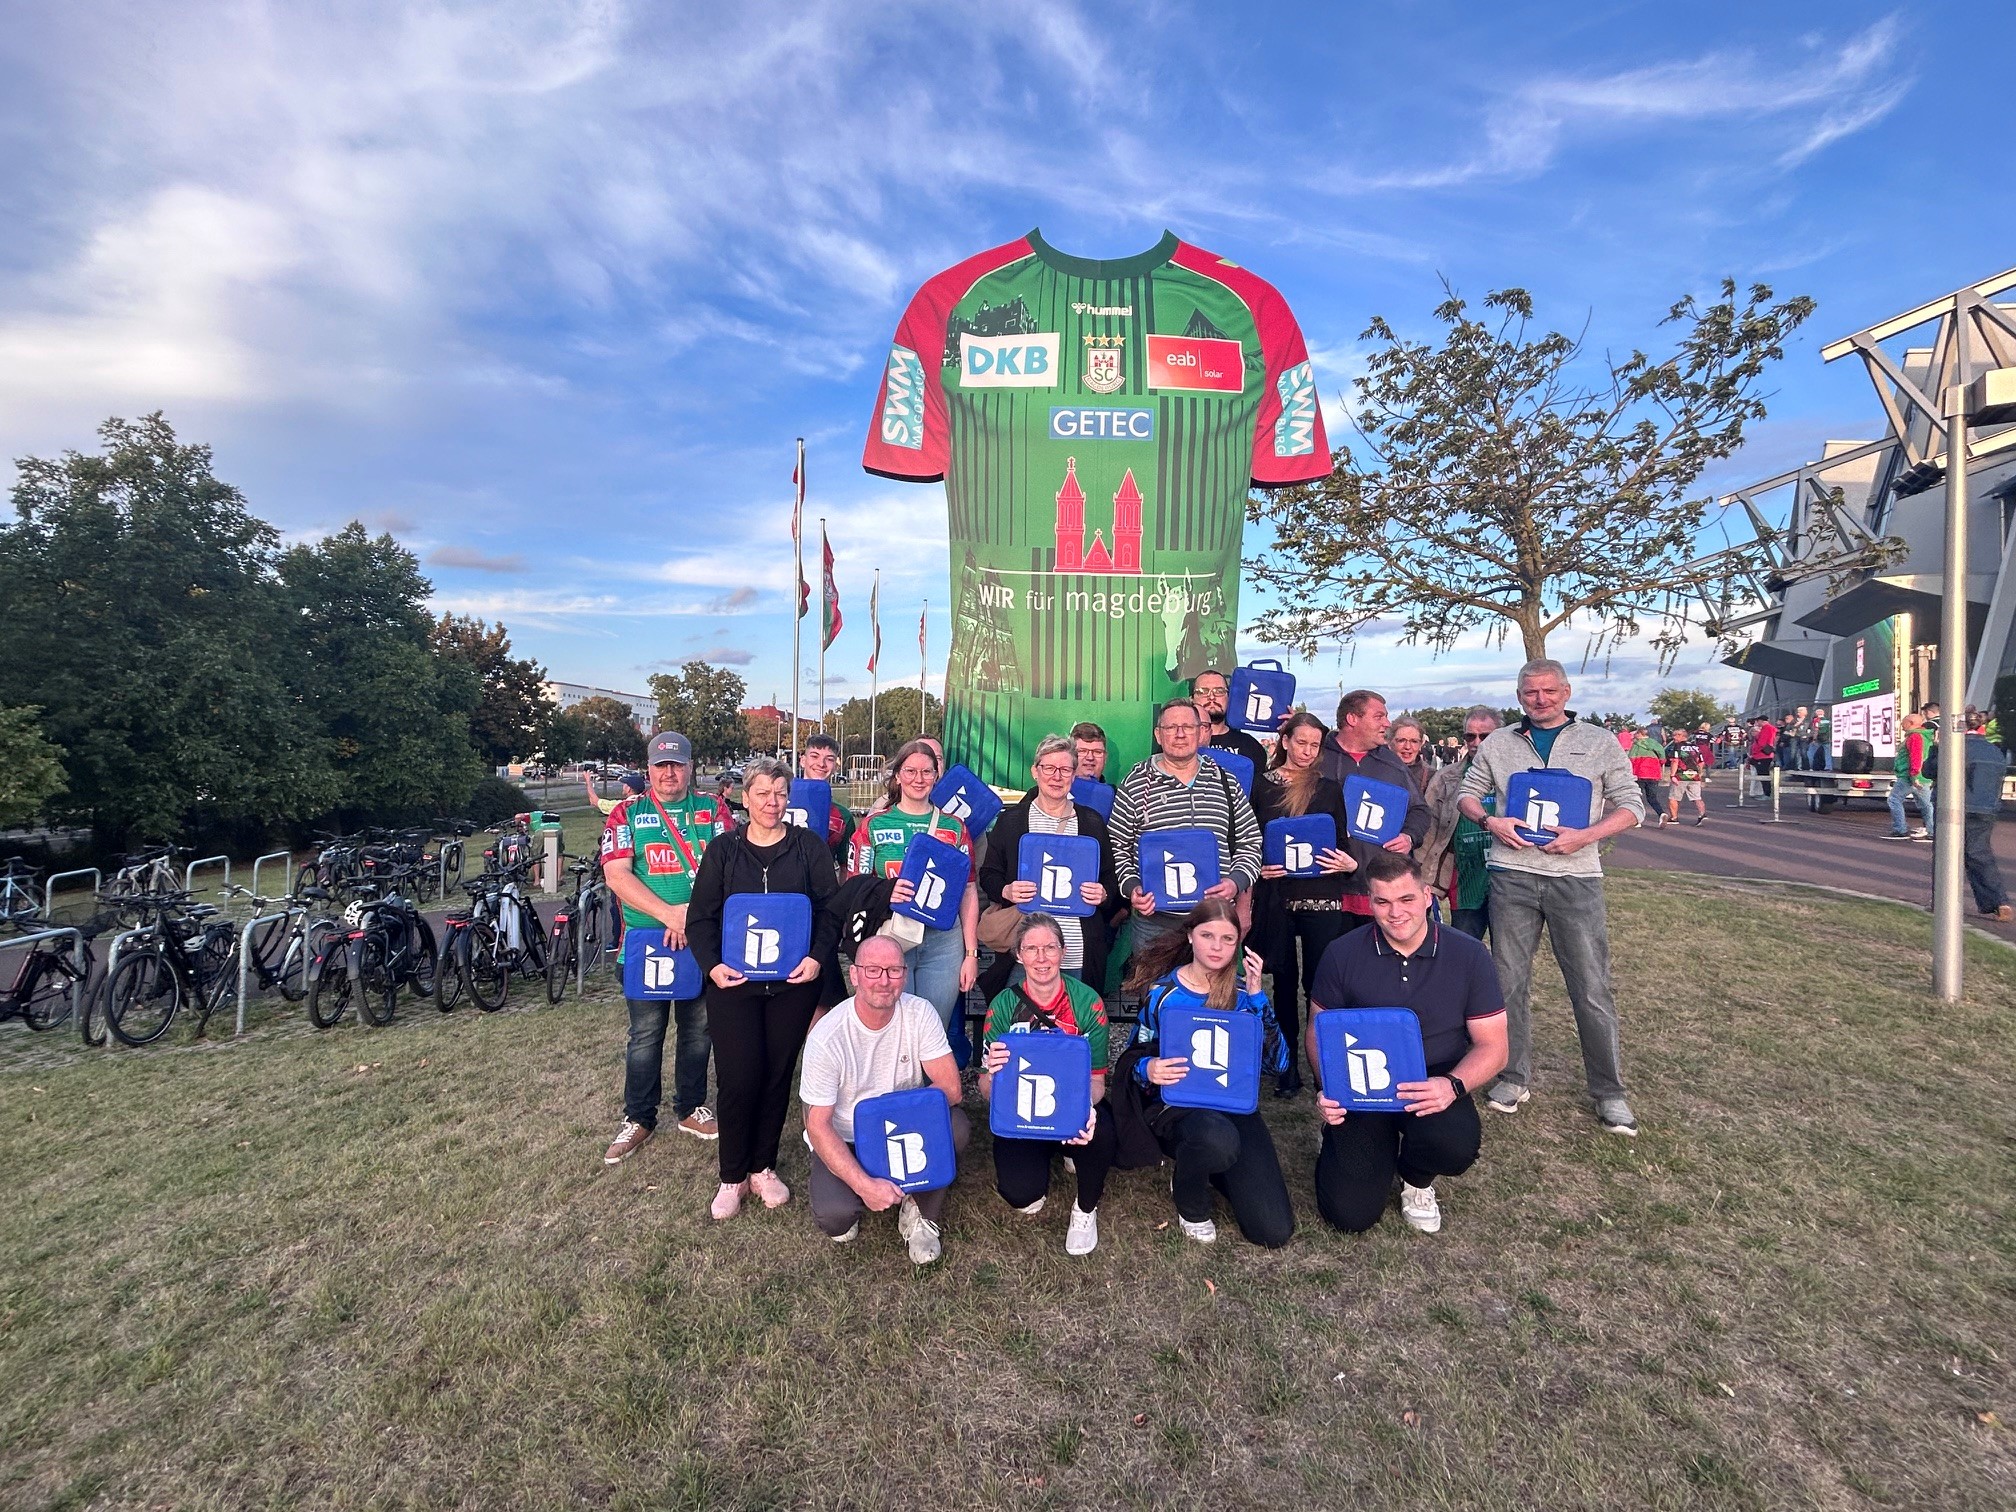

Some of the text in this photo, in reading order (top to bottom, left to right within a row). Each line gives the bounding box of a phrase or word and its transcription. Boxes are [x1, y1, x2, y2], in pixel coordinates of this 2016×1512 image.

[1086, 305, 1132, 316] hummel
[968, 345, 1048, 375] DKB
[1166, 350, 1197, 367] eab
[1094, 367, 1114, 381] SC
[1204, 369, 1224, 379] solar
[882, 350, 916, 444] SWM
[1276, 375, 1292, 455] MAGBURG
[1289, 363, 1316, 455] SWM
[1053, 410, 1150, 438] GETEC
[978, 583, 1212, 619] WIR für magdeburg
[636, 815, 659, 825] DKB
[876, 832, 902, 842] DKB
